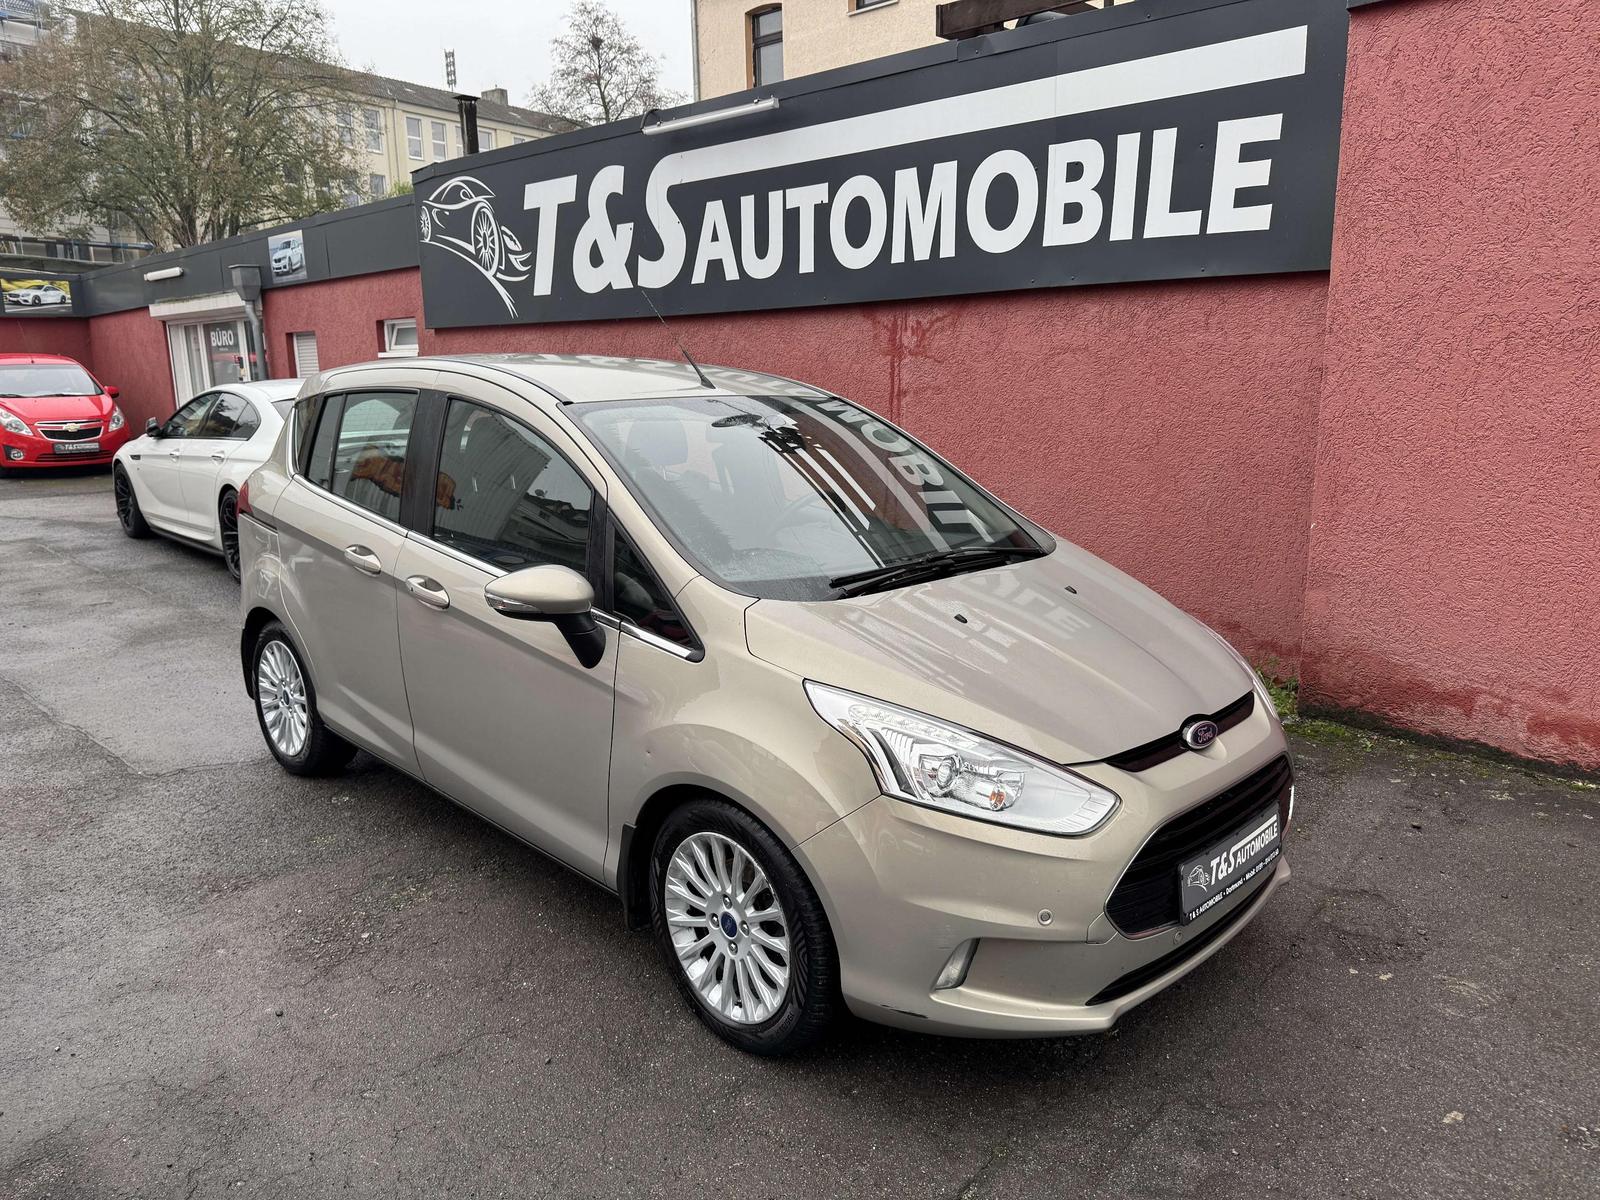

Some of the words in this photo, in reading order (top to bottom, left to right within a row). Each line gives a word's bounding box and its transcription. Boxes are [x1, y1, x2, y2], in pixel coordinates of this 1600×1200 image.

[522, 153, 706, 297] T&S
[691, 113, 1284, 285] AUTOMOBILE
[210, 328, 234, 346] BÜRO
[1197, 726, 1213, 743] Ford
[1210, 846, 1237, 885] T&S
[1235, 822, 1278, 868] AUTOMOBILE
